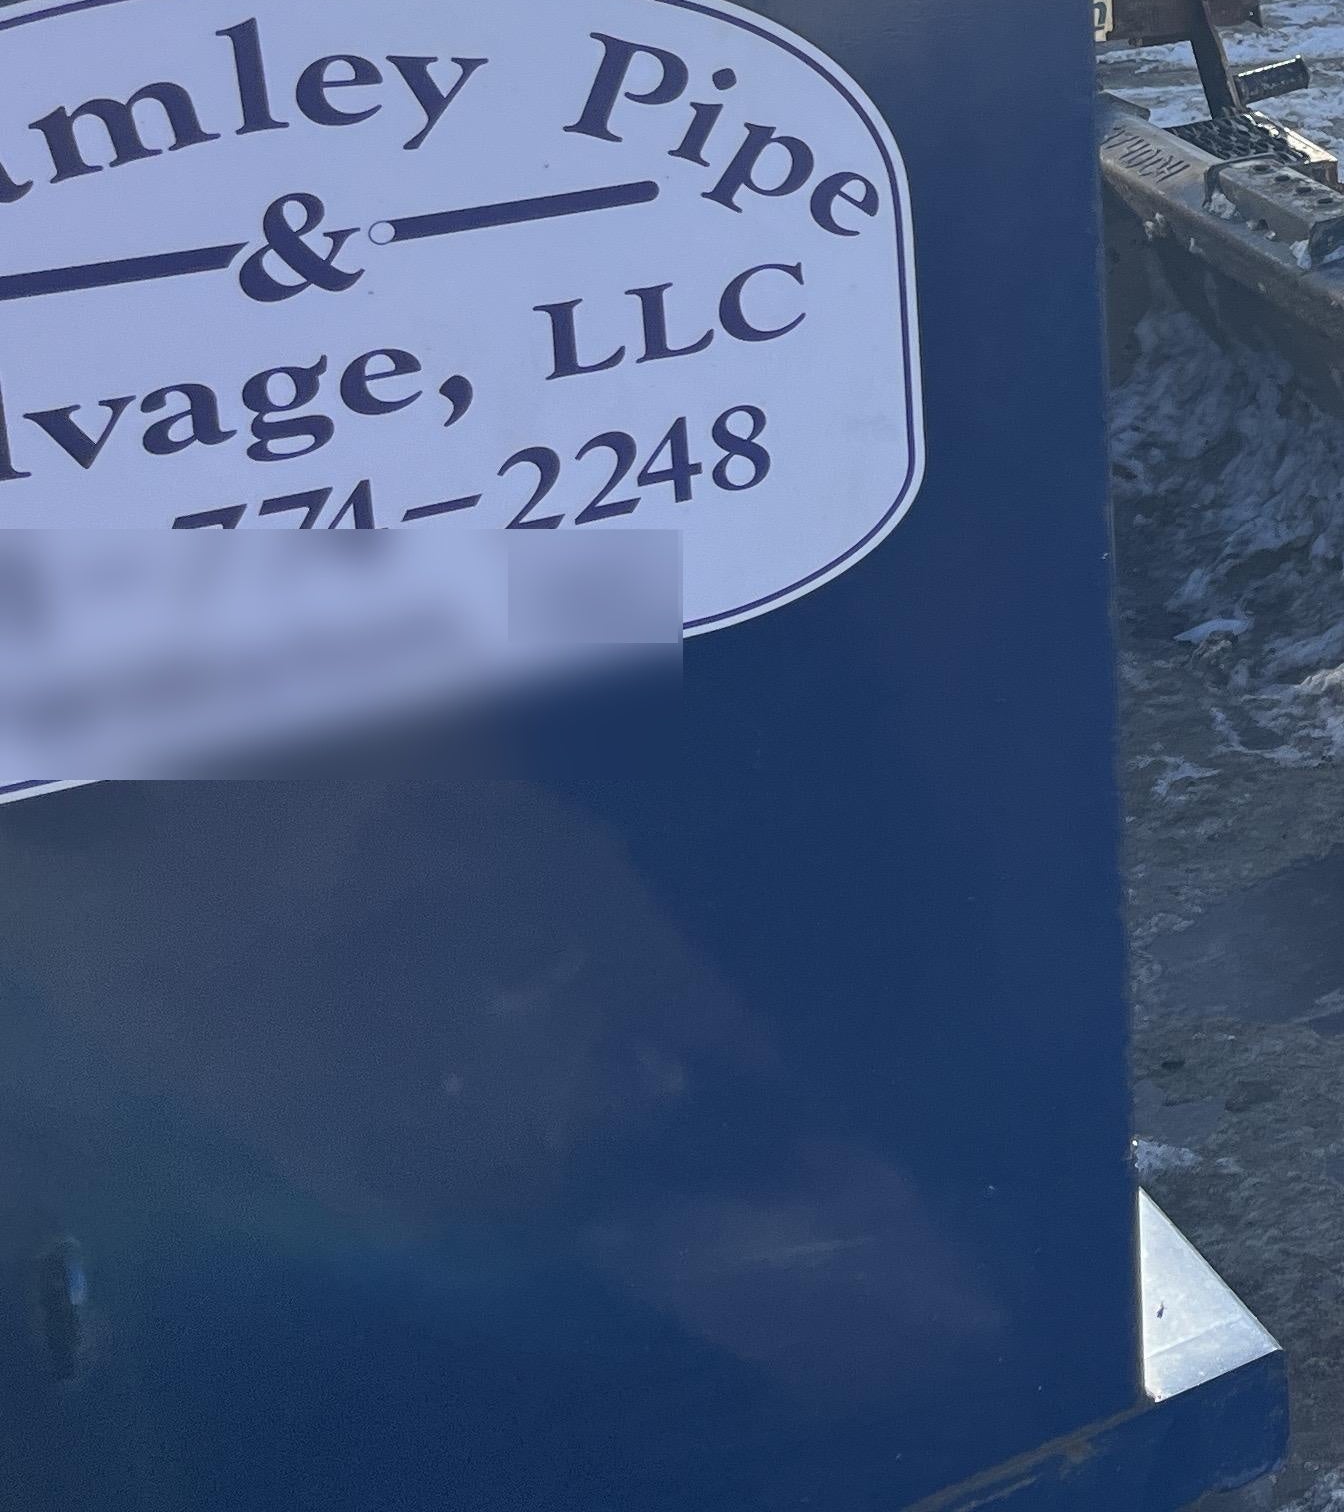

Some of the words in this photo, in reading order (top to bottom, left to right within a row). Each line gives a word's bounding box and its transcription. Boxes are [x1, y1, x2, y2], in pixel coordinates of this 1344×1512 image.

[0, 18, 489, 204] mley
[562, 31, 880, 238] Pipe
[238, 192, 366, 303] &
[0, 349, 474, 483] vage,
[533, 262, 806, 381] LLC
